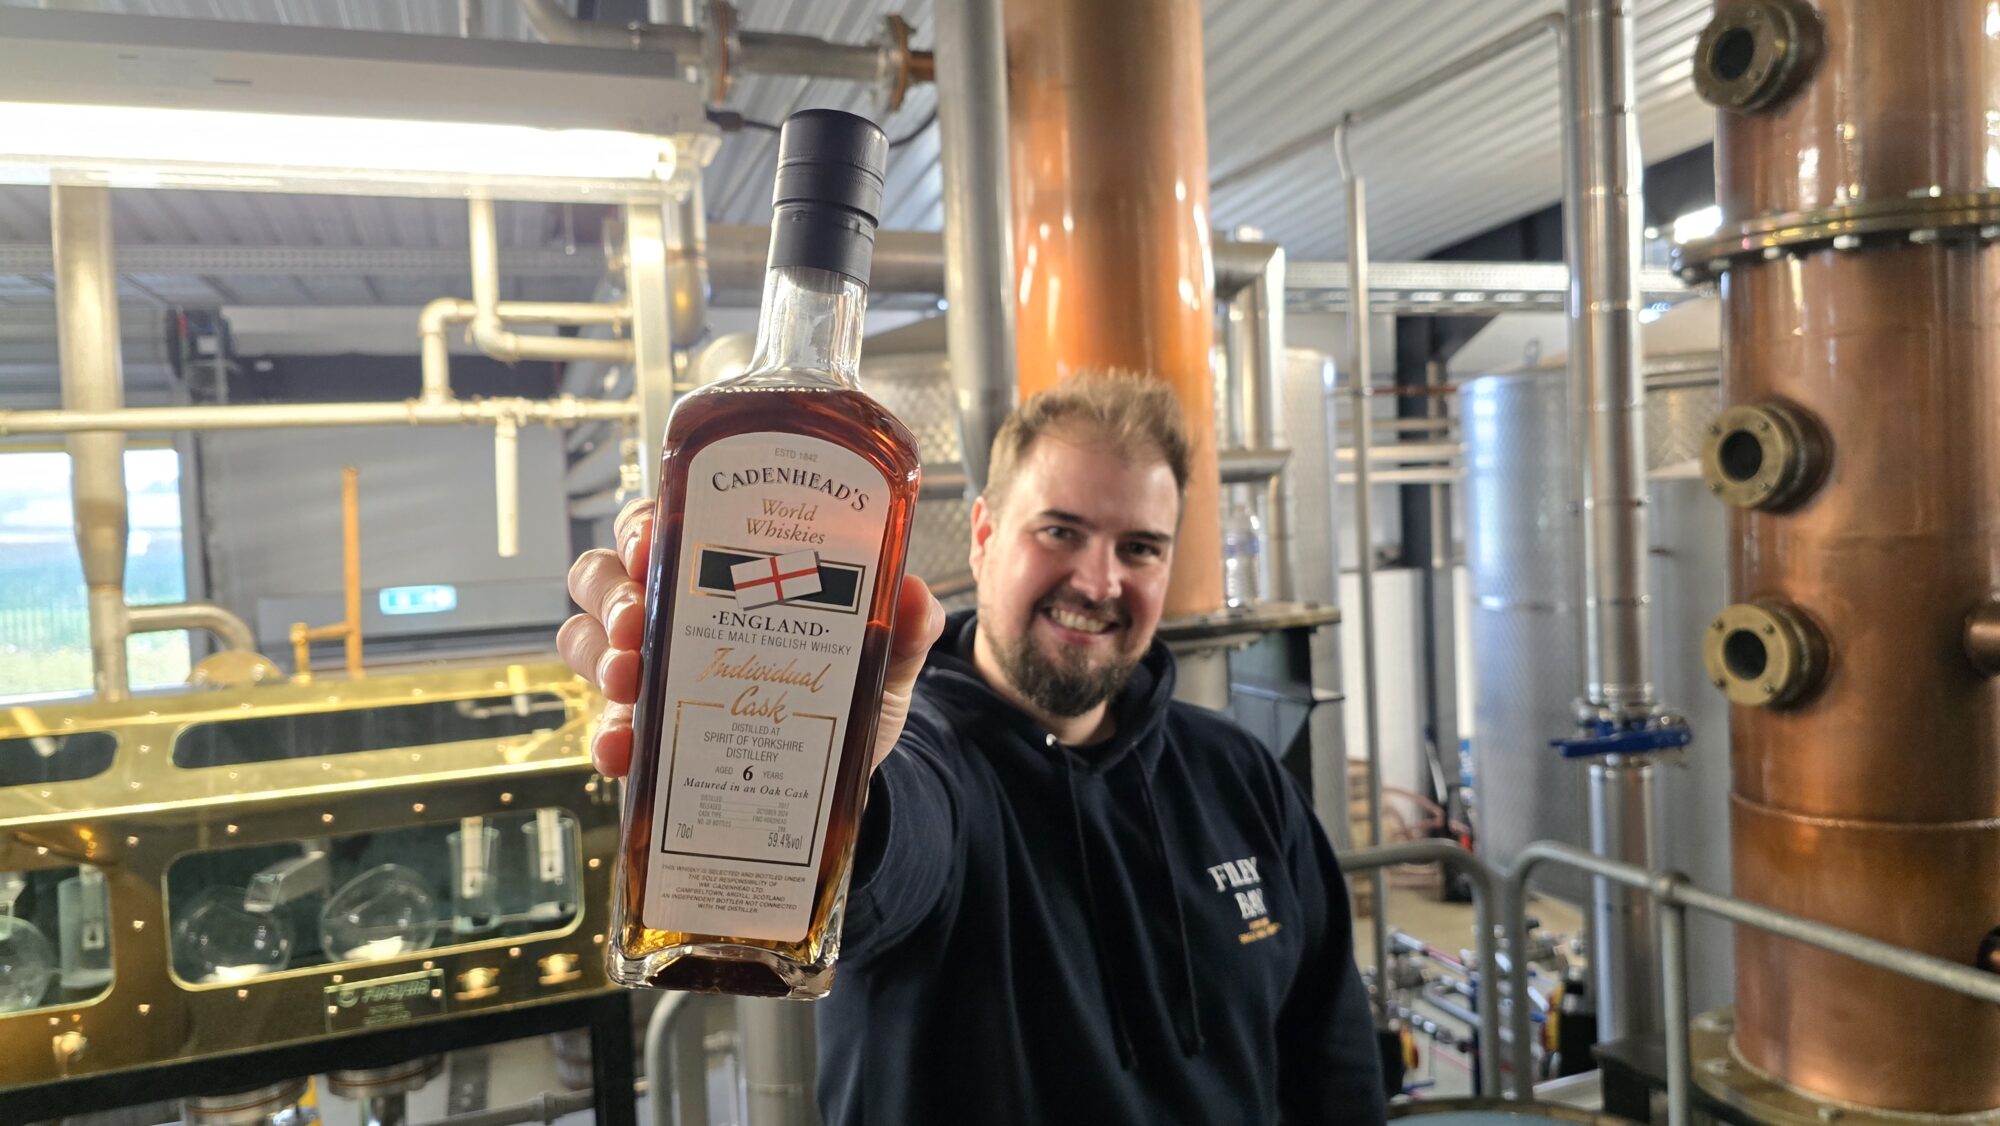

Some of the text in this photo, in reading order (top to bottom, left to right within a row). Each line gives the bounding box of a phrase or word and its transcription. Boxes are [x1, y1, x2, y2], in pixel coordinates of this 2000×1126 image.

[775, 447, 818, 463] ESTD 1842
[712, 467, 869, 512] CADENHEAD'S
[762, 498, 819, 521] World
[745, 517, 826, 545] Whiskies
[685, 625, 852, 656] SINGLE MALT ENGLISH WHISKY
[696, 647, 832, 693] Individual
[731, 685, 788, 724] Cask
[732, 722, 781, 736] DISTILLED AT
[703, 731, 805, 753] SPIRIT OF YORKSHIRE
[726, 747, 780, 764] DISTILLERY
[715, 765, 784, 781] AGED 6 YEARS
[683, 777, 809, 800] Matured in an Oak Cask
[708, 869, 740, 877] SELECTED
